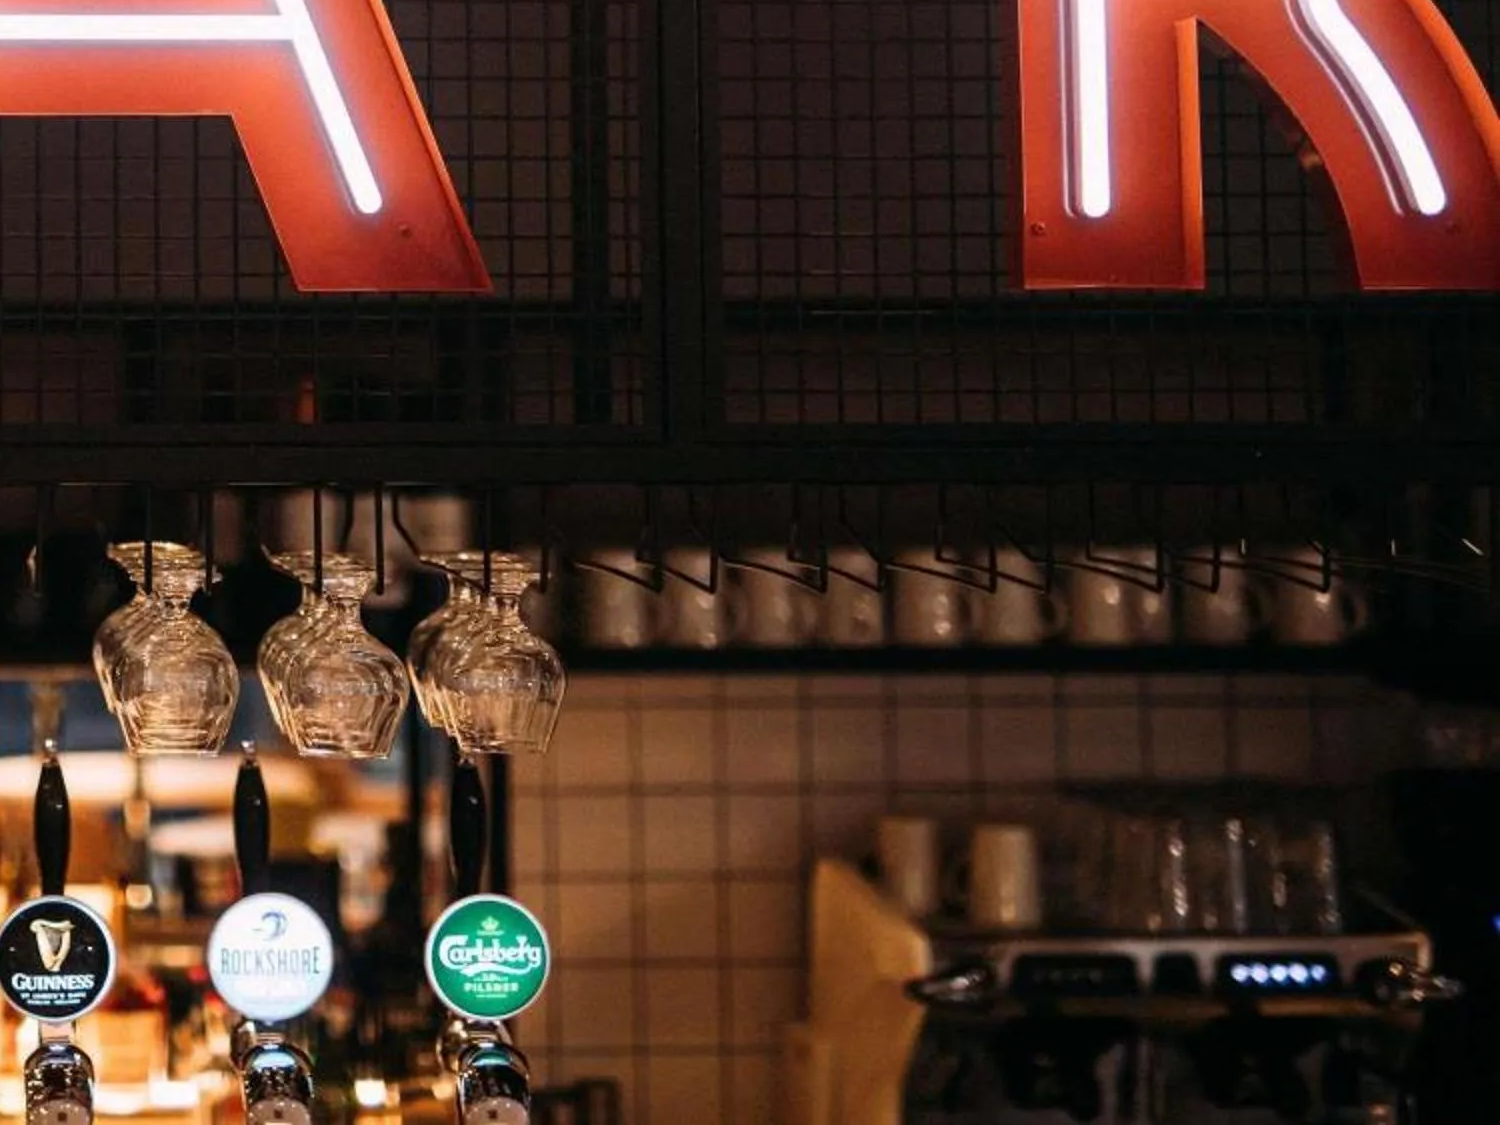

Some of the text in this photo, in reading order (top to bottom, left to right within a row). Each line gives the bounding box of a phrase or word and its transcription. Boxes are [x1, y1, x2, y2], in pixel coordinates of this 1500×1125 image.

[220, 945, 321, 976] ROCKSHORE
[439, 935, 541, 975] Carlsberg
[11, 972, 95, 991] GUINNESS
[463, 982, 519, 992] PILSNER
